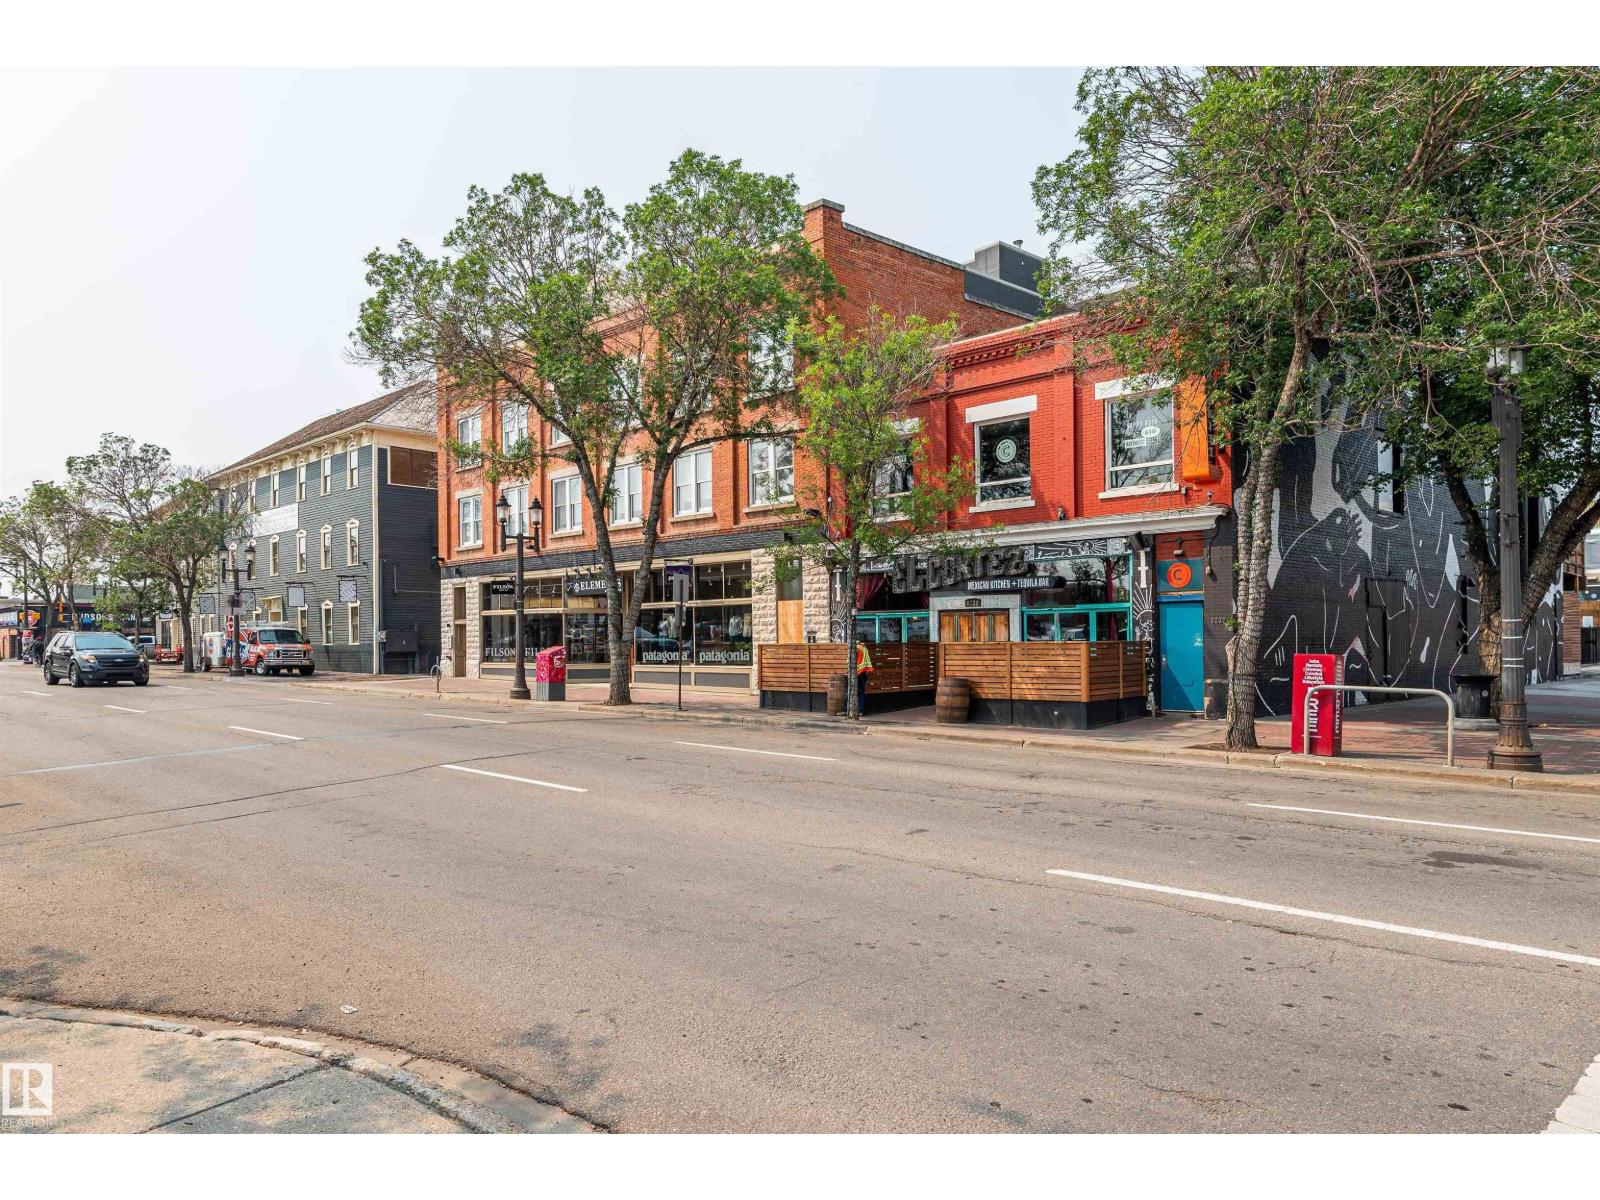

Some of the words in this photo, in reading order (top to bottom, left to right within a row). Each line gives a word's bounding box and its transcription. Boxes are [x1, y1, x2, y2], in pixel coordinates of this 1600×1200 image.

[967, 581, 990, 591] MEXICAN
[990, 580, 1011, 590] KITCHEN
[1017, 578, 1038, 588] TEQUILA
[1038, 577, 1049, 587] BAR
[485, 647, 516, 657] FILSON
[642, 650, 688, 664] patagona
[700, 649, 750, 664] patagonia
